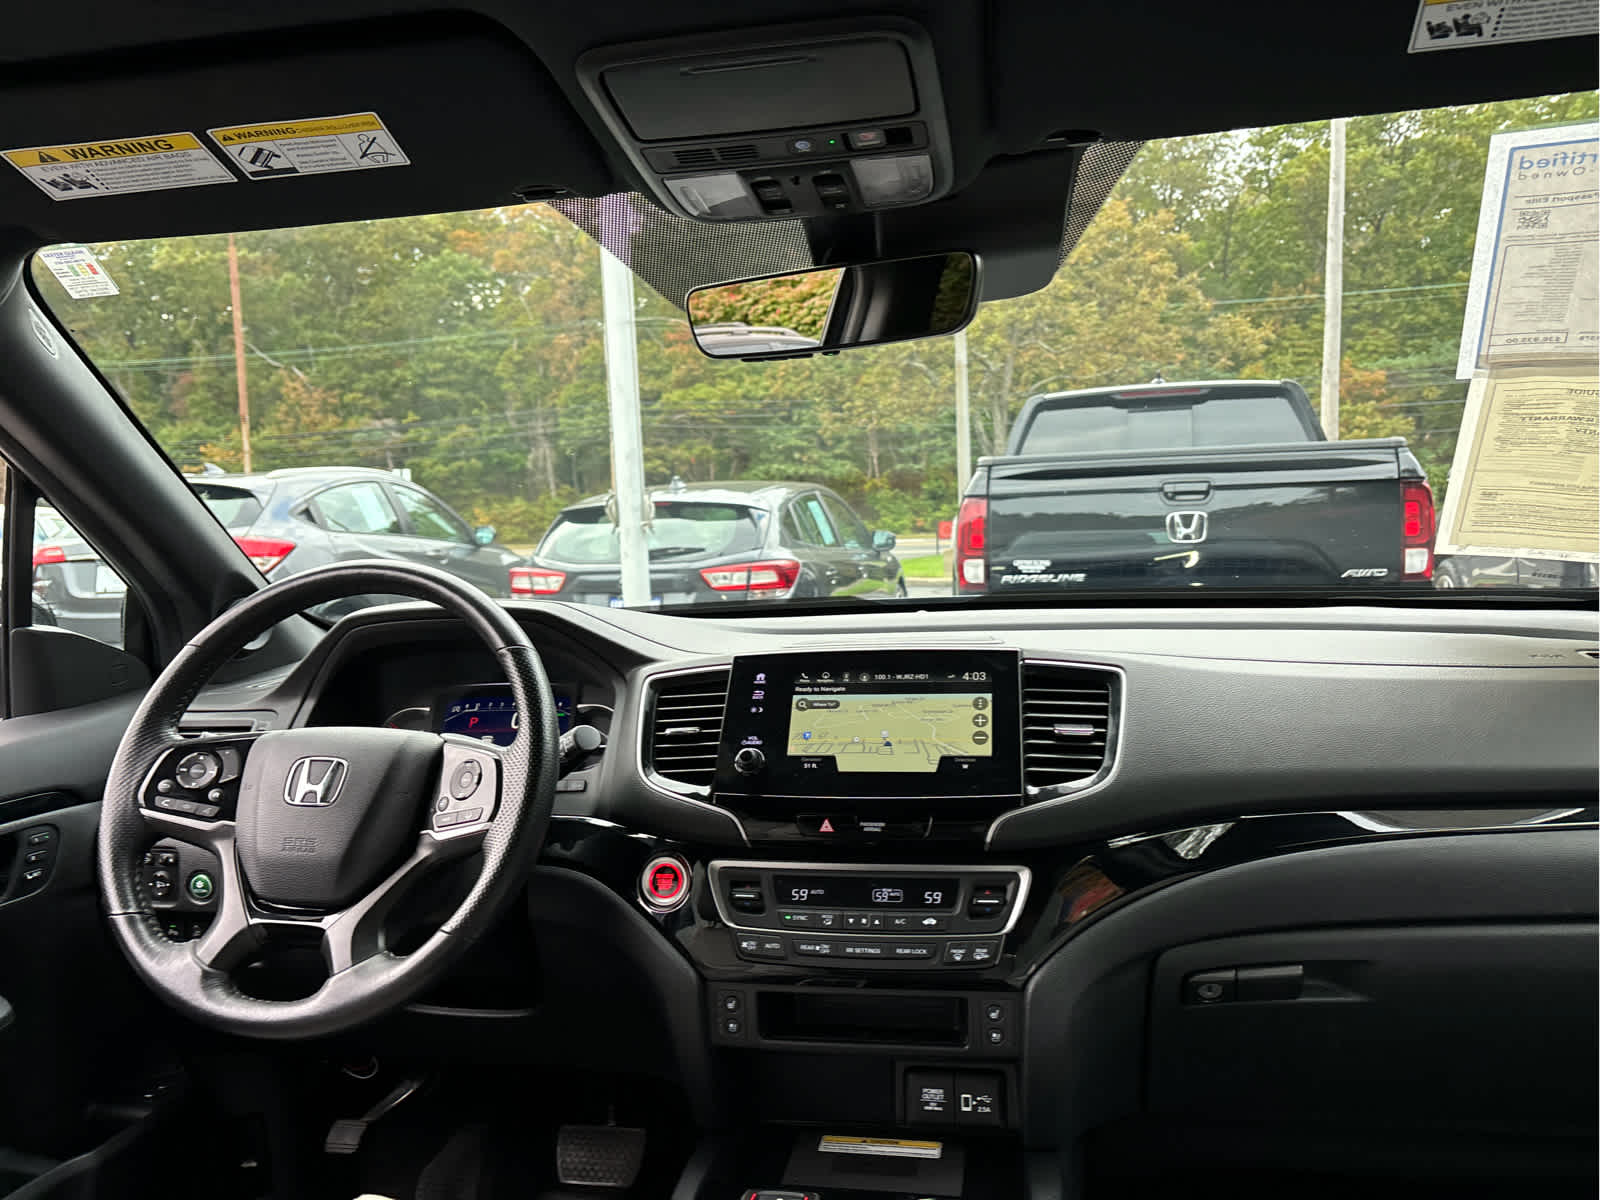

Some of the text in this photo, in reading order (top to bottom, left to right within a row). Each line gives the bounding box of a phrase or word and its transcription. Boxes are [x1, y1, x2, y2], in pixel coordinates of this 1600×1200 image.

[64, 139, 174, 160] WARNING
[1000, 573, 1087, 584] RIDGELINE
[1340, 568, 1388, 578] AWD
[962, 671, 987, 681] 4:03
[468, 717, 480, 729] P
[791, 889, 808, 901] 59
[875, 891, 889, 901] 59
[924, 891, 943, 904] 59
